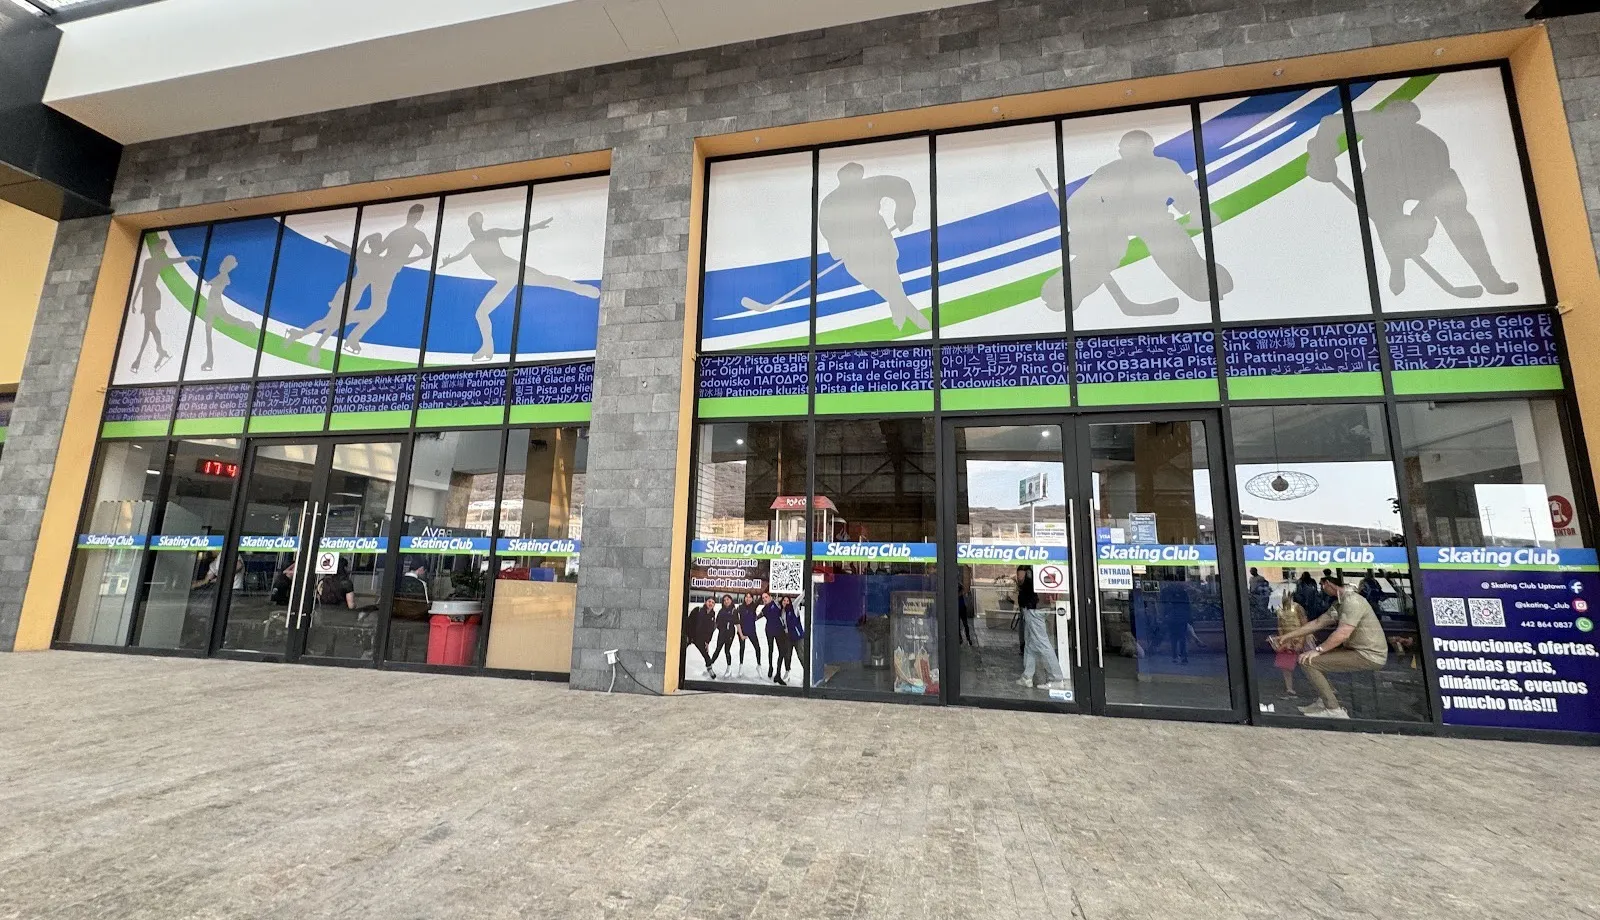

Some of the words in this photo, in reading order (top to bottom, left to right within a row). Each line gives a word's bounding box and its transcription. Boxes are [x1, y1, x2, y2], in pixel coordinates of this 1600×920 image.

[744, 355, 769, 365] Pista
[772, 354, 785, 364] de
[893, 348, 909, 358] Ice
[978, 342, 1032, 353] Patinoire
[1036, 338, 1083, 350] kluziě
[1087, 337, 1134, 348] Glacies
[1138, 334, 1167, 346] Rink
[1232, 327, 1309, 341] Lodowisko
[1428, 318, 1465, 330] Pista
[1471, 316, 1491, 329] de
[1496, 314, 1533, 327] Gelo
[720, 365, 753, 377] Oighir
[829, 360, 854, 371] Pista
[858, 359, 868, 369] di
[873, 356, 934, 370] Pattinaggi
[942, 355, 980, 367] 아이스
[986, 353, 1011, 365] 링크
[1016, 352, 1044, 362] Pista
[1049, 351, 1064, 360] de
[1194, 344, 1213, 353] Ice
[1301, 335, 1367, 348] Patinoire
[1437, 329, 1492, 341] Glacies
[1498, 326, 1538, 338] Rink
[700, 377, 750, 388] odowisko
[836, 372, 862, 382] Pista
[866, 371, 880, 380] de
[884, 370, 910, 380] Gelo
[963, 364, 1016, 377] スケートリンク
[1022, 364, 1048, 374] Rinc
[1052, 361, 1092, 373] Oihir
[1226, 352, 1238, 364] di
[1244, 351, 1329, 364] Pattinaggio
[1427, 344, 1465, 356] Pista
[1470, 342, 1490, 354] de
[1496, 341, 1538, 354] Hielo
[280, 380, 312, 389] Patinoire
[346, 377, 372, 385] Glacies
[375, 376, 392, 384] Rink
[429, 371, 473, 380] Lodowisko
[541, 366, 562, 374] Pista
[565, 365, 576, 373] de
[726, 387, 772, 397] Patinoire
[820, 384, 846, 393] Pista
[850, 383, 864, 392] de
[868, 381, 898, 392] Hielo
[952, 376, 1016, 388] Lodowisko
[1118, 371, 1149, 382] Pista
[1154, 370, 1170, 380] de
[1175, 369, 1206, 379] Gelo
[1394, 359, 1428, 370] Rink
[1434, 354, 1505, 368] スケートリンク
[206, 392, 213, 400] di
[320, 387, 330, 395] de
[421, 382, 438, 390] Rink
[467, 379, 505, 387] Patinoire
[544, 374, 575, 383] Glacies
[191, 402, 207, 410] Pista
[220, 400, 236, 408] Gelo
[433, 389, 481, 400] Pattinaggio
[537, 385, 558, 395] Pista
[560, 384, 572, 393] de
[259, 406, 298, 416] Lodowisko
[358, 403, 375, 412] Pista
[378, 402, 388, 410] de
[390, 402, 409, 410] Gelo
[516, 396, 535, 405] Rink
[86, 534, 116, 547] Skating
[116, 535, 134, 545] Club
[158, 536, 189, 548] Skating
[190, 537, 209, 547] Club
[241, 536, 274, 548] Skating
[275, 537, 295, 548] Club
[320, 537, 356, 551] Skating
[356, 538, 378, 549] Club
[410, 537, 449, 551] Skating
[450, 538, 473, 550] Club
[508, 539, 549, 554] Skating
[550, 540, 575, 552] Club
[706, 541, 753, 556] Skating
[754, 541, 783, 554] Club
[826, 543, 878, 559] Skating
[879, 544, 911, 556] Club
[958, 545, 1013, 562] Skating
[1015, 546, 1048, 560] Club
[1100, 545, 1160, 562] Skating
[1162, 546, 1199, 560] Club
[1264, 547, 1330, 565] Skating
[1333, 548, 1374, 563] Club
[1438, 547, 1511, 567] Skating
[1514, 549, 1560, 565] Club
[697, 558, 710, 566] Ven
[716, 558, 738, 566] tomar
[738, 559, 758, 567] parte
[708, 568, 717, 576] de
[718, 569, 745, 577] nuestro
[1100, 568, 1130, 576] ENTRADA
[692, 578, 715, 587] Equipo
[1490, 582, 1518, 590] Skating
[1433, 638, 1536, 655] Promociones,
[1538, 641, 1599, 657] ofertas,
[1436, 657, 1504, 672] entradas
[1506, 659, 1556, 675] gratis,
[1439, 675, 1522, 692] dinámicas,
[1524, 679, 1588, 694] eventos
[1442, 695, 1451, 709] y
[1454, 695, 1506, 710] mucho
[1508, 696, 1558, 712] más!!!
